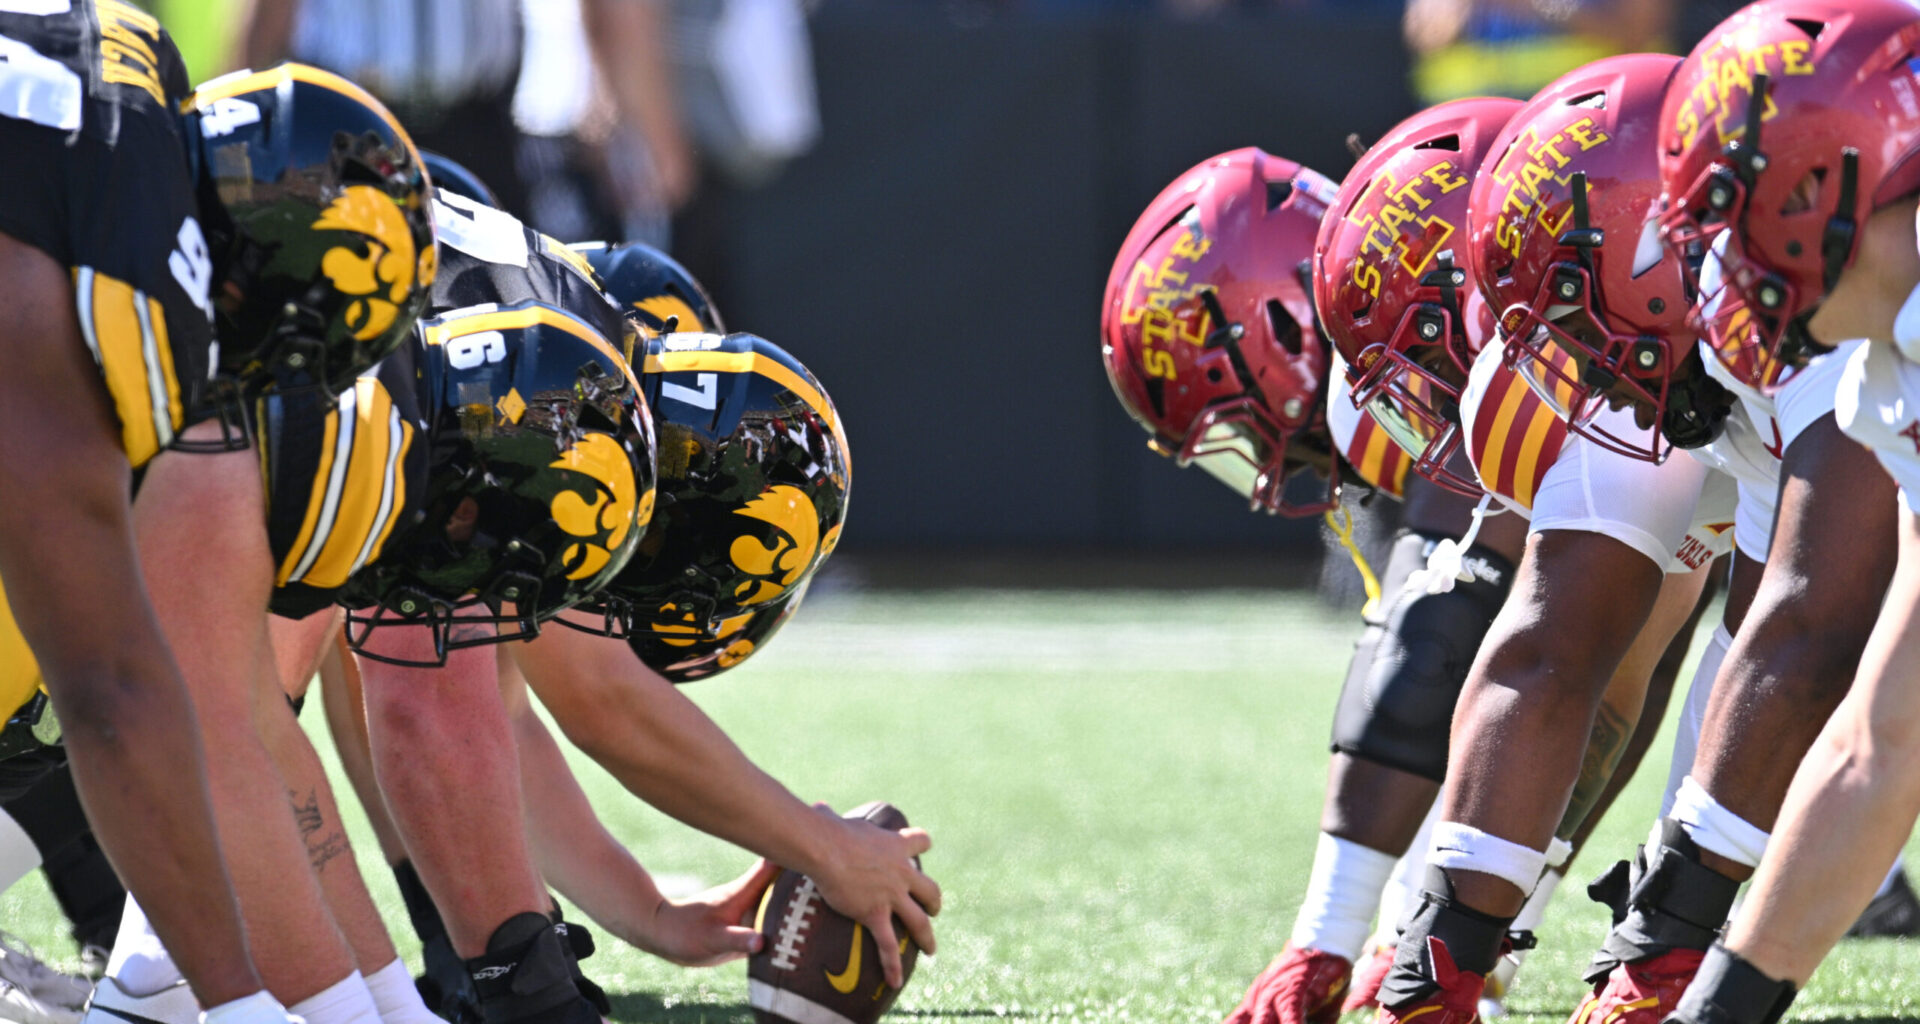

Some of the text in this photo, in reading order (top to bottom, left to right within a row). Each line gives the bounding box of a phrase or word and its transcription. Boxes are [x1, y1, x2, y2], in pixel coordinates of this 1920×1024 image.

[1676, 40, 1815, 149] STATE
[1353, 161, 1468, 299] STATE
[1496, 117, 1608, 259] STATE
[1142, 232, 1212, 381] STATE
